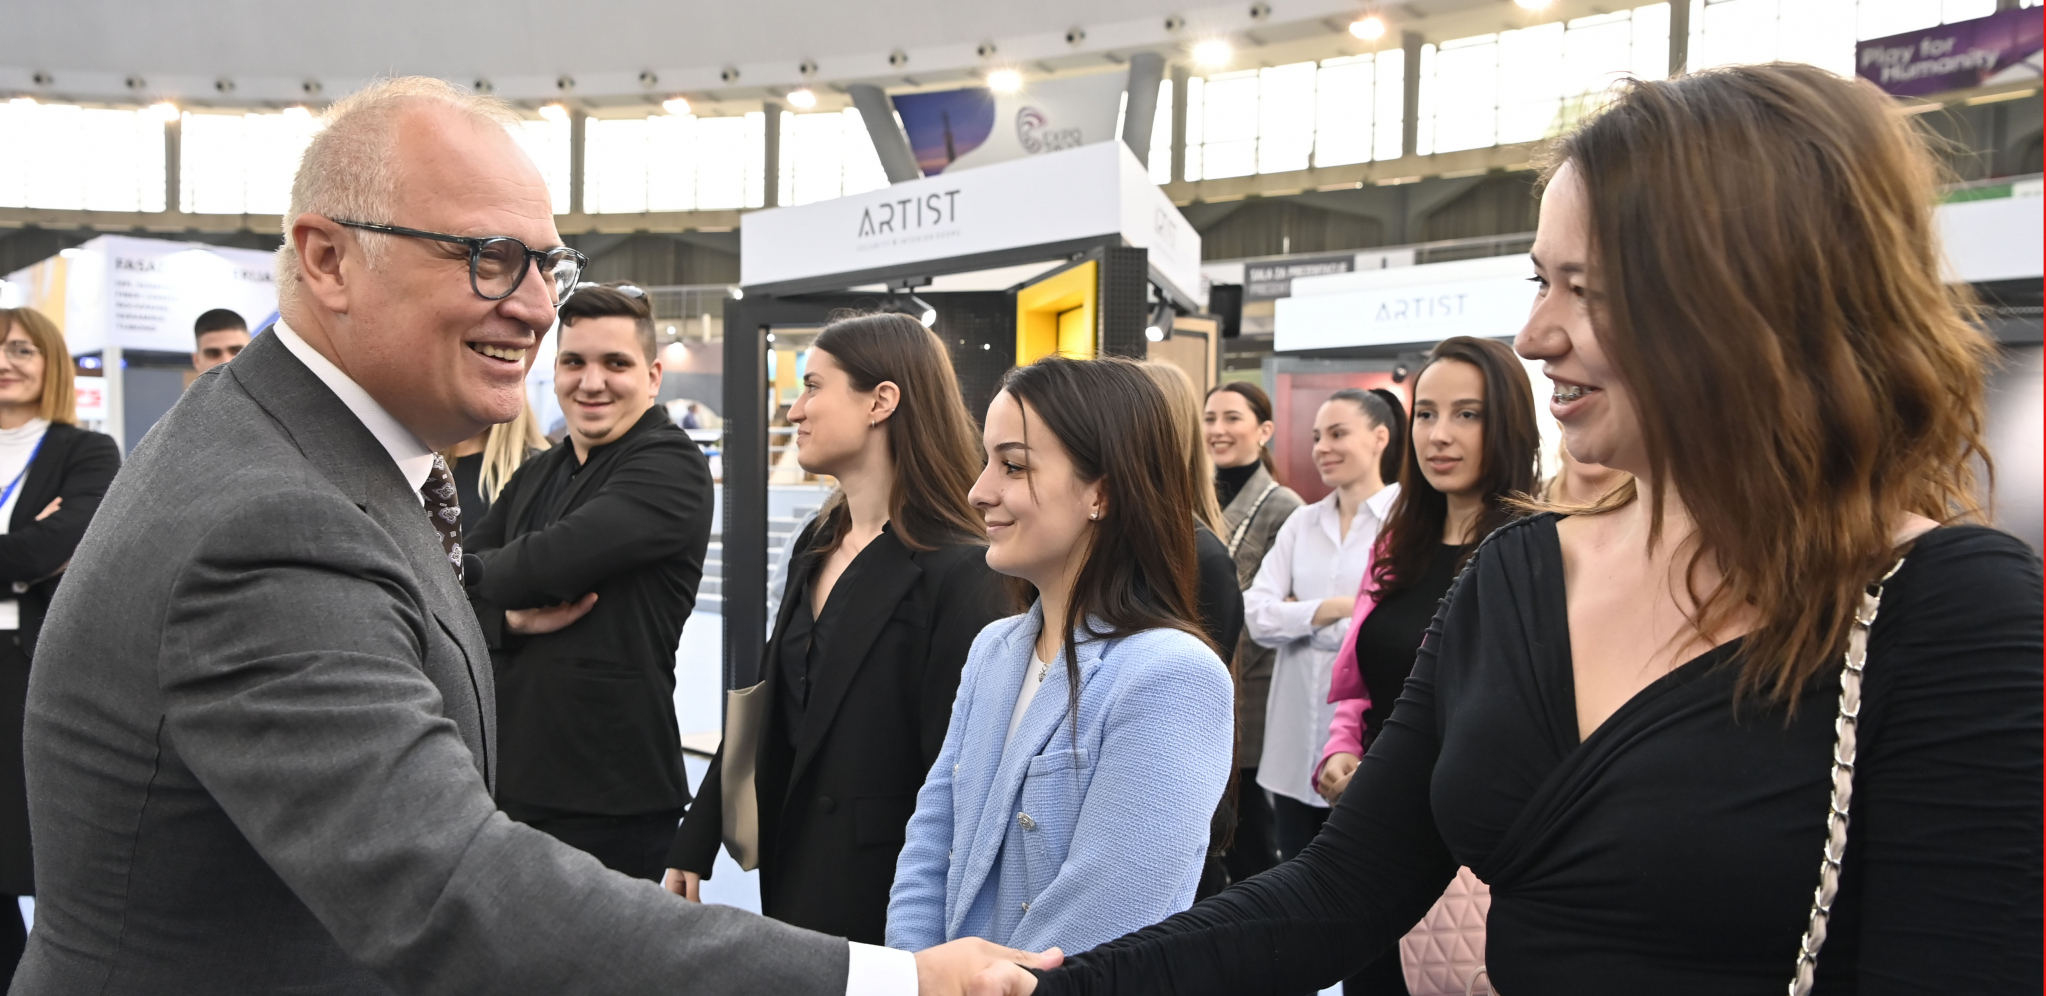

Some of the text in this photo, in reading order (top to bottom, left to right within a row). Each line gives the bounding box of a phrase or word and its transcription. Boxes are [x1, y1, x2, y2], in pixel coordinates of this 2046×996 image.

[1861, 37, 1957, 69] Play for
[1880, 49, 1999, 84] Humanity
[858, 190, 961, 238] ARTIST
[1375, 293, 1469, 322] ARTIST
